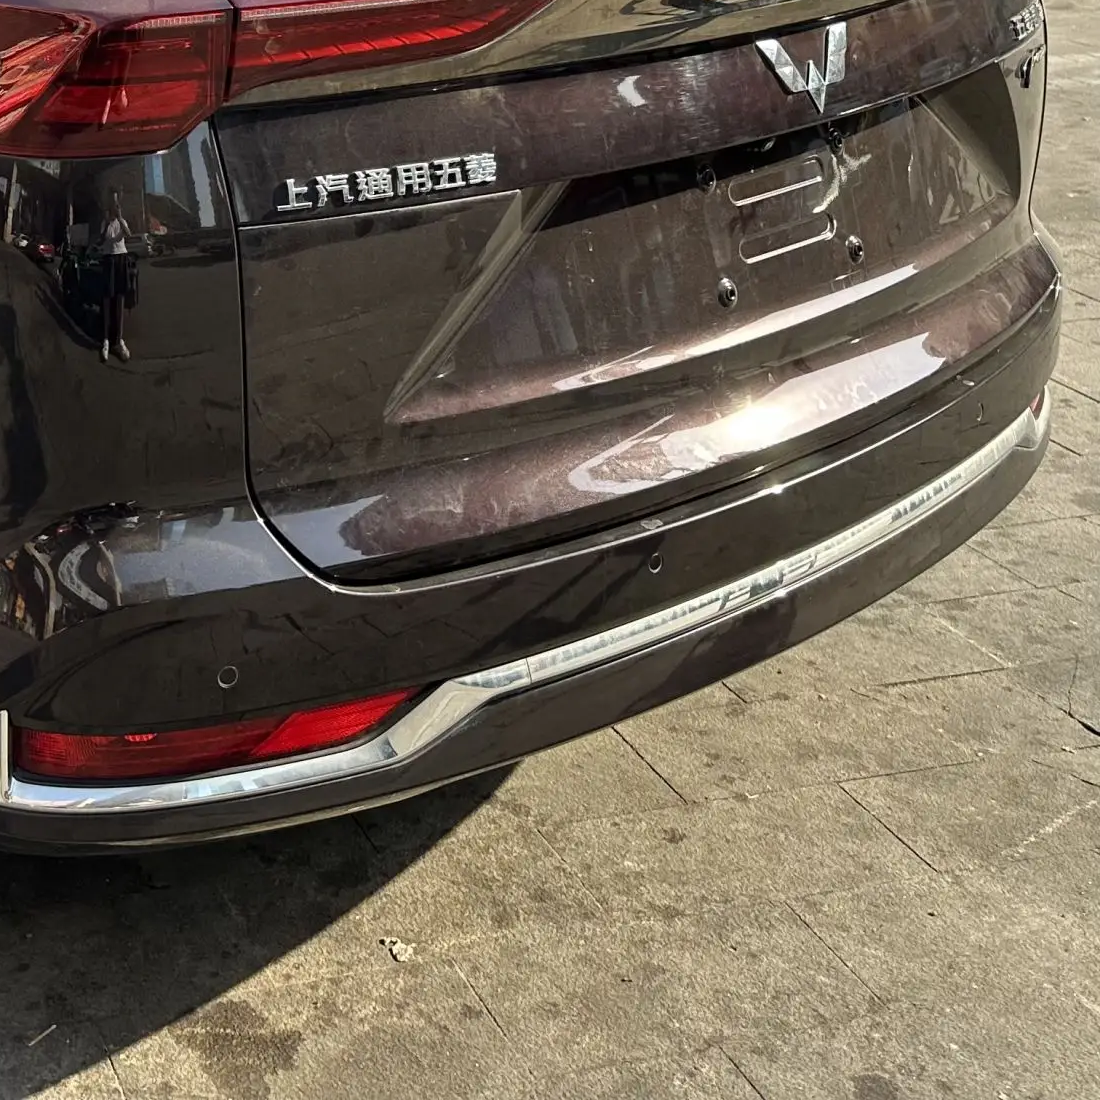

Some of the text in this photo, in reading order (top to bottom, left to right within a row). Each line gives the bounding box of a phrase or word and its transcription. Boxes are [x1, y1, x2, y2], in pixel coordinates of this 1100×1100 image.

[277, 153, 497, 212] 上汽通用五菱
